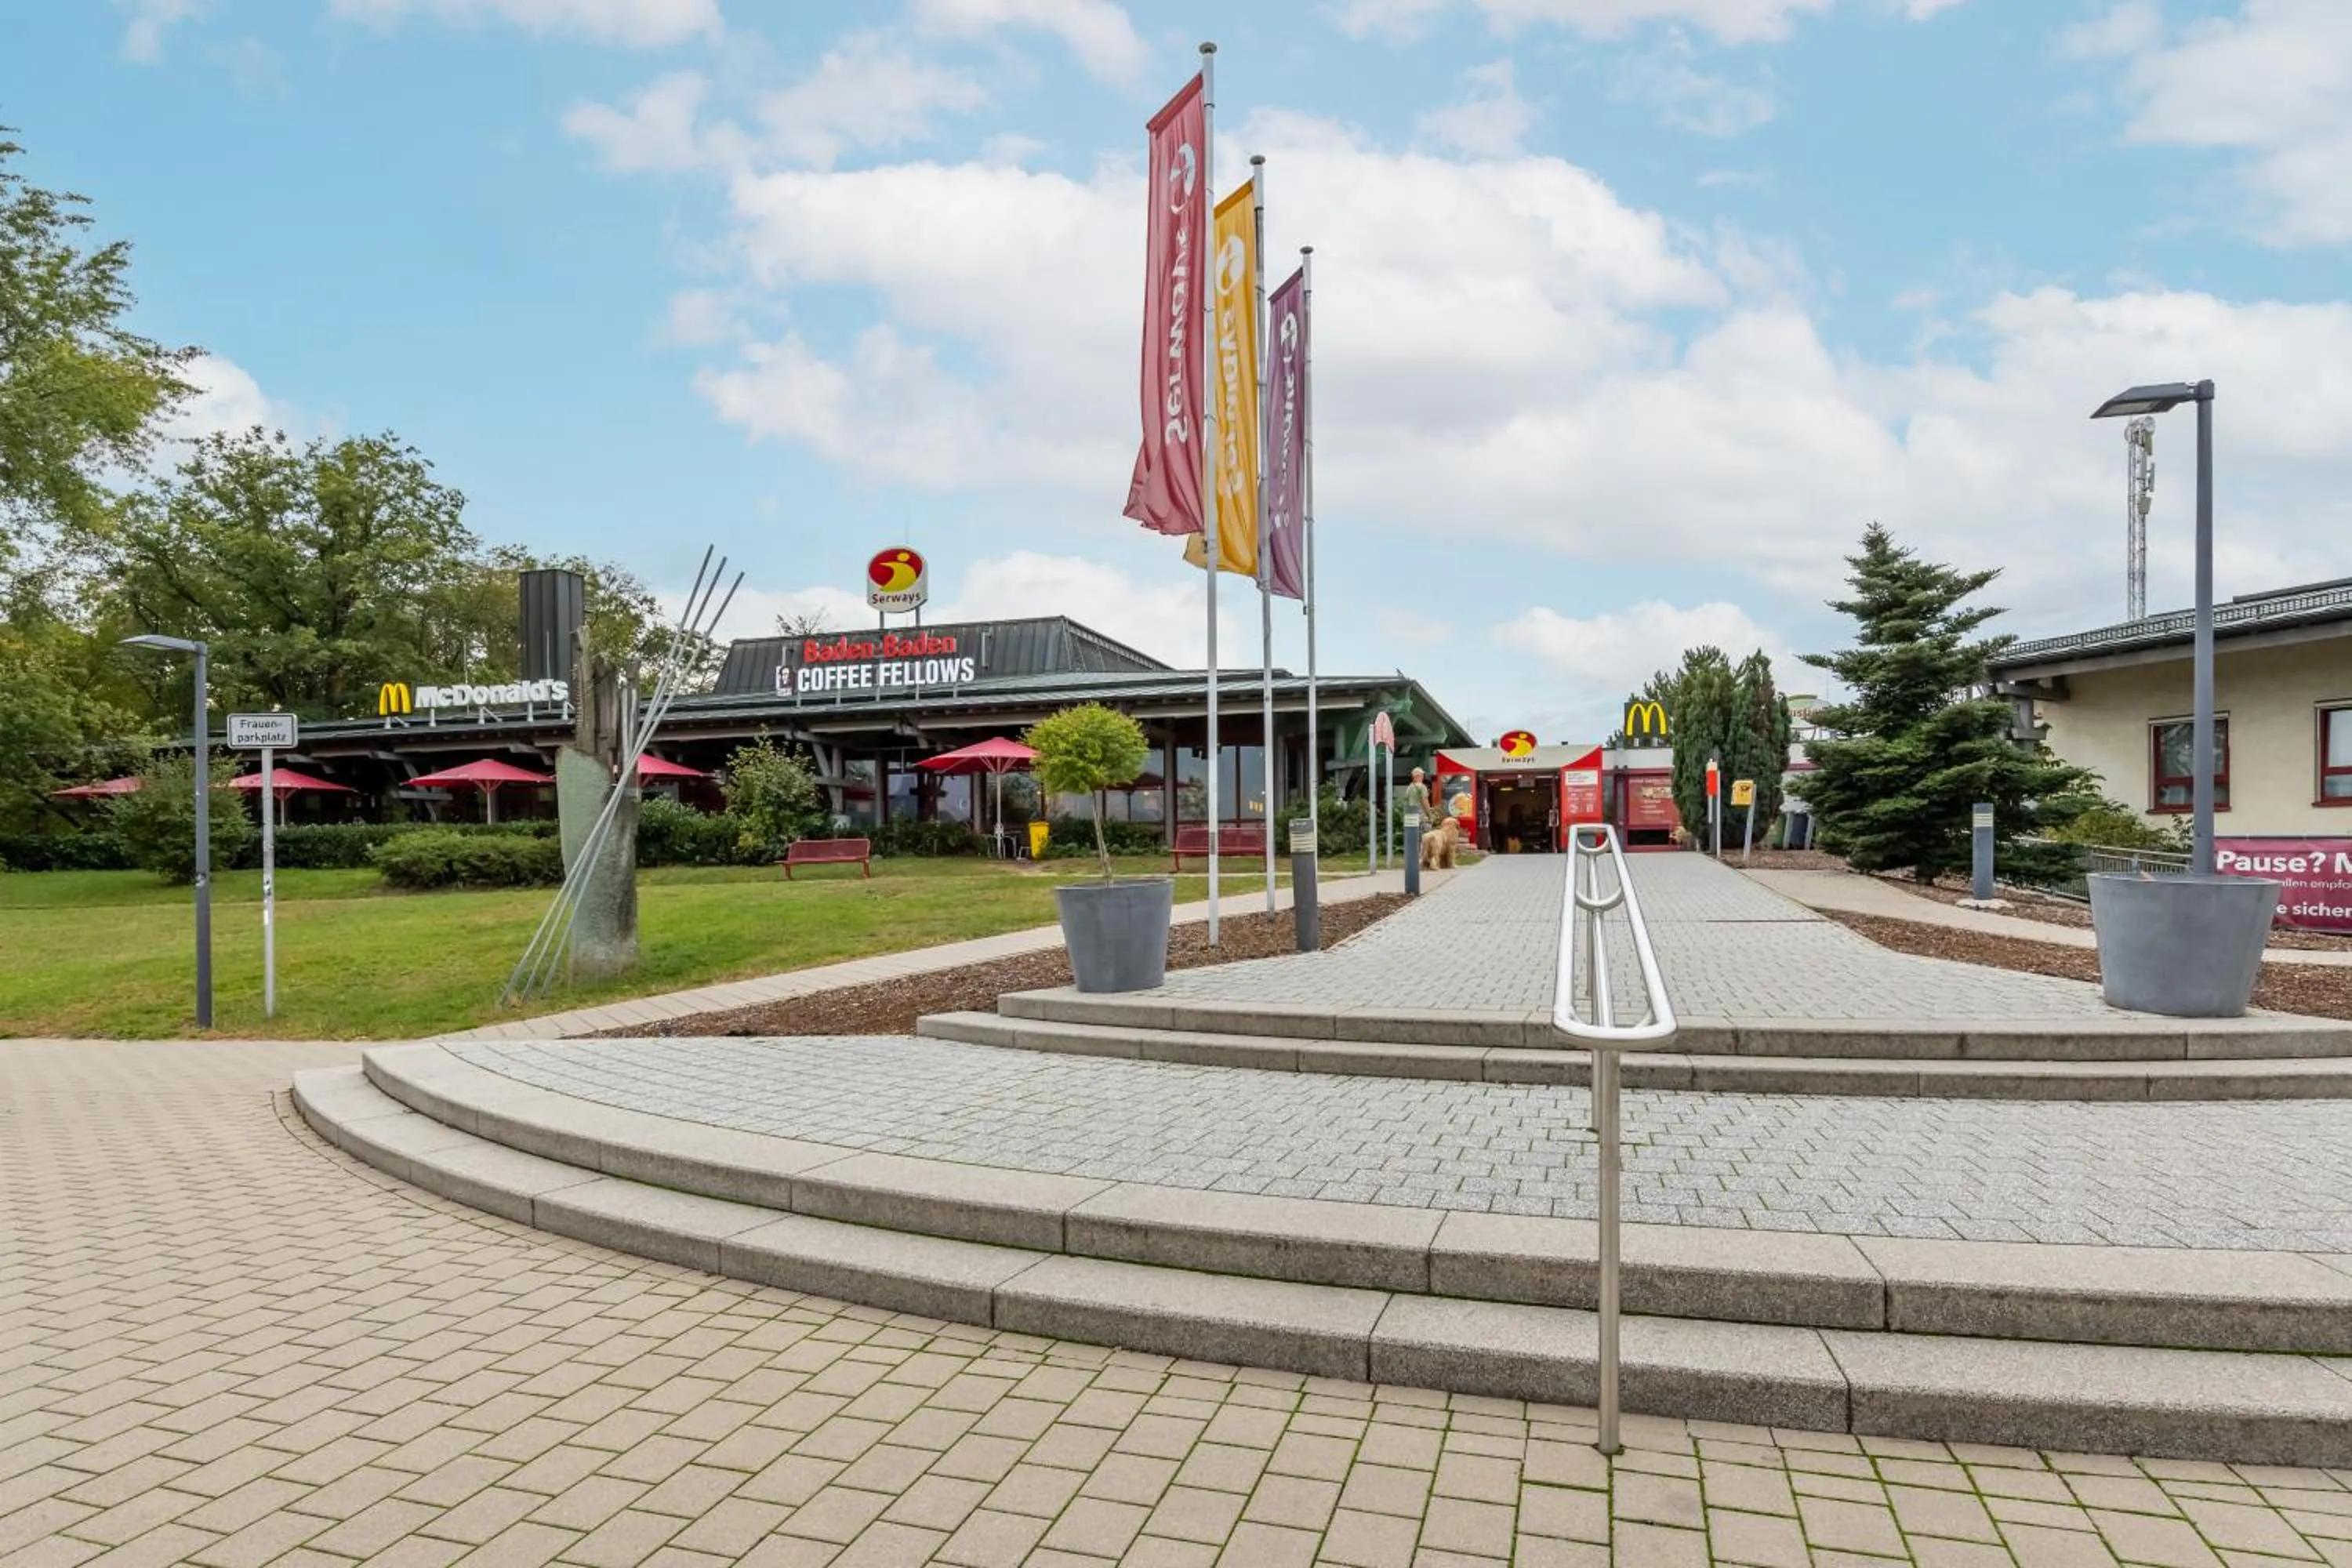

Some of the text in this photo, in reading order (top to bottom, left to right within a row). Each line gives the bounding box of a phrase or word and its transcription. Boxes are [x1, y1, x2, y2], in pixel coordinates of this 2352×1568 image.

[872, 592, 922, 604] Serways
[804, 632, 957, 663] Baden-Baden
[797, 657, 975, 692] COFFEE FELLOWS
[415, 678, 569, 708] McDonald's
[240, 719, 283, 728] Frauen-
[238, 731, 287, 743] parkplatz
[2216, 851, 2327, 873] Pause?
